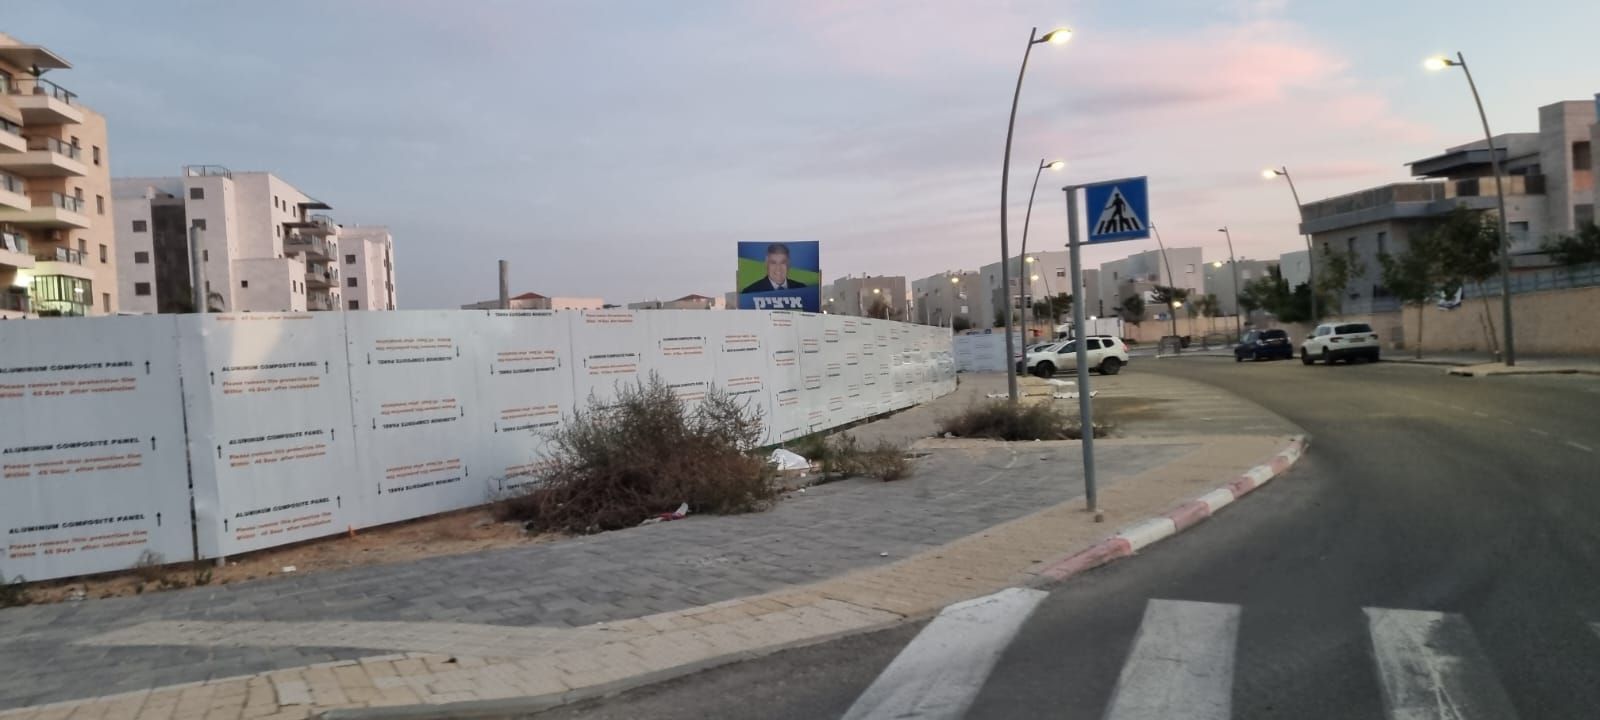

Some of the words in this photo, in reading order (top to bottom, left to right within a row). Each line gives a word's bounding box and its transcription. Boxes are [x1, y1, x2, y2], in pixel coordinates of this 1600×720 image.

[50, 362, 102, 371] COMPOSITE
[267, 431, 303, 441] COMPOSITE
[56, 439, 108, 450] COMPOSITE
[111, 437, 139, 445] PANEL
[9, 523, 59, 534] ALUMINUM
[62, 517, 114, 528] COMPOSITE
[117, 514, 145, 522] PANEL
